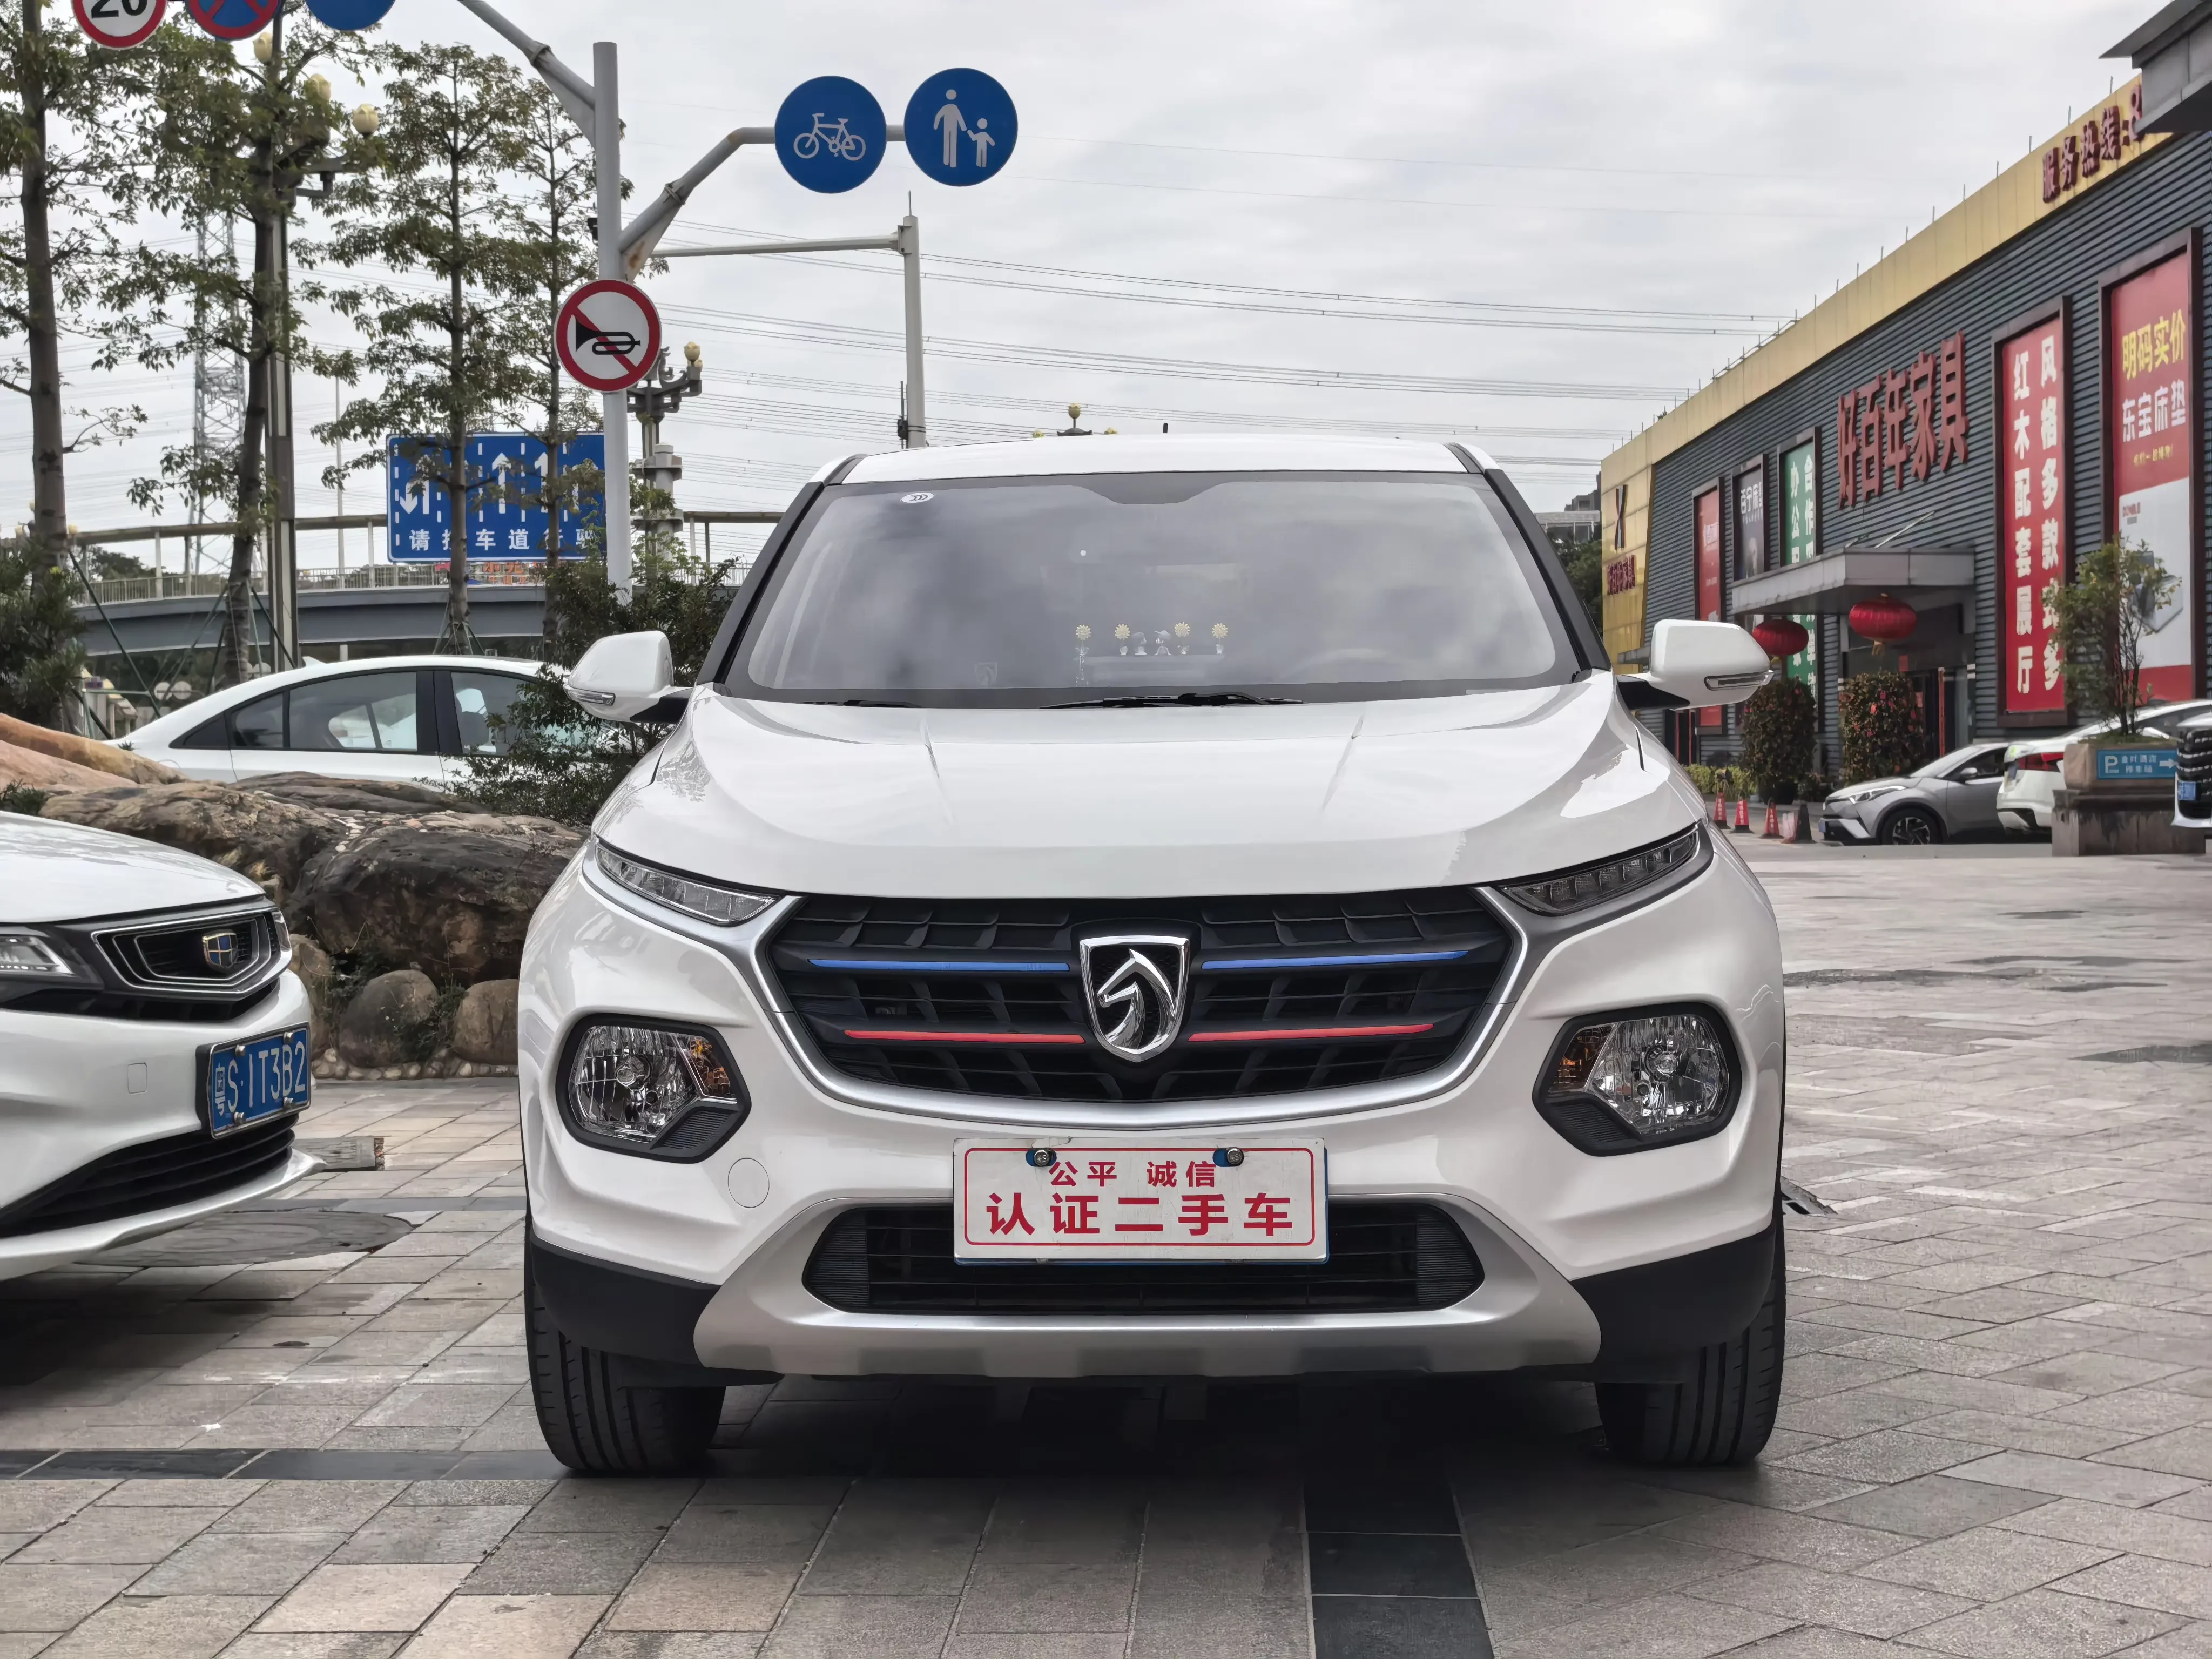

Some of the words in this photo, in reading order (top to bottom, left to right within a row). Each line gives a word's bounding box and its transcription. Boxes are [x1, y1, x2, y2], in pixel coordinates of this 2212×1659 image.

[2122, 308, 2186, 381] 明码实价
[2122, 379, 2186, 443] 东宝床垫
[2013, 350, 2033, 694] 红木配套展厅
[1048, 1161, 1117, 1187] 公平
[1147, 1160, 1216, 1188] 诚信
[986, 1192, 1293, 1237] 认证二手车
